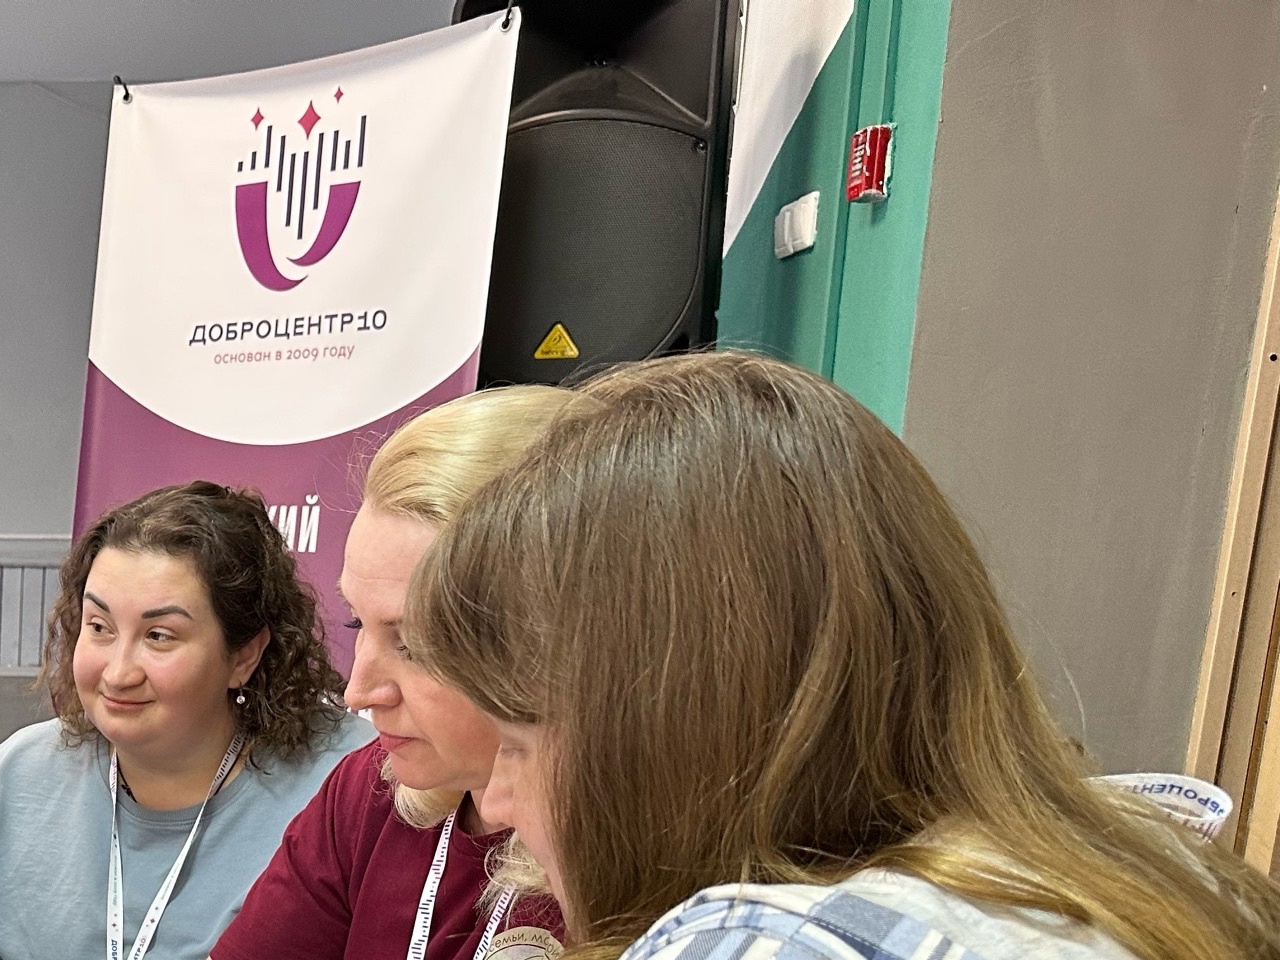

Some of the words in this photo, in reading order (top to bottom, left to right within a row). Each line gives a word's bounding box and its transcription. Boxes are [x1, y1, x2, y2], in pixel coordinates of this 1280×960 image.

[189, 309, 388, 347] ДОБРОЦЕНТР10
[213, 351, 271, 365] основан
[275, 350, 282, 361] в
[286, 348, 320, 362] 2009
[322, 344, 356, 360] году
